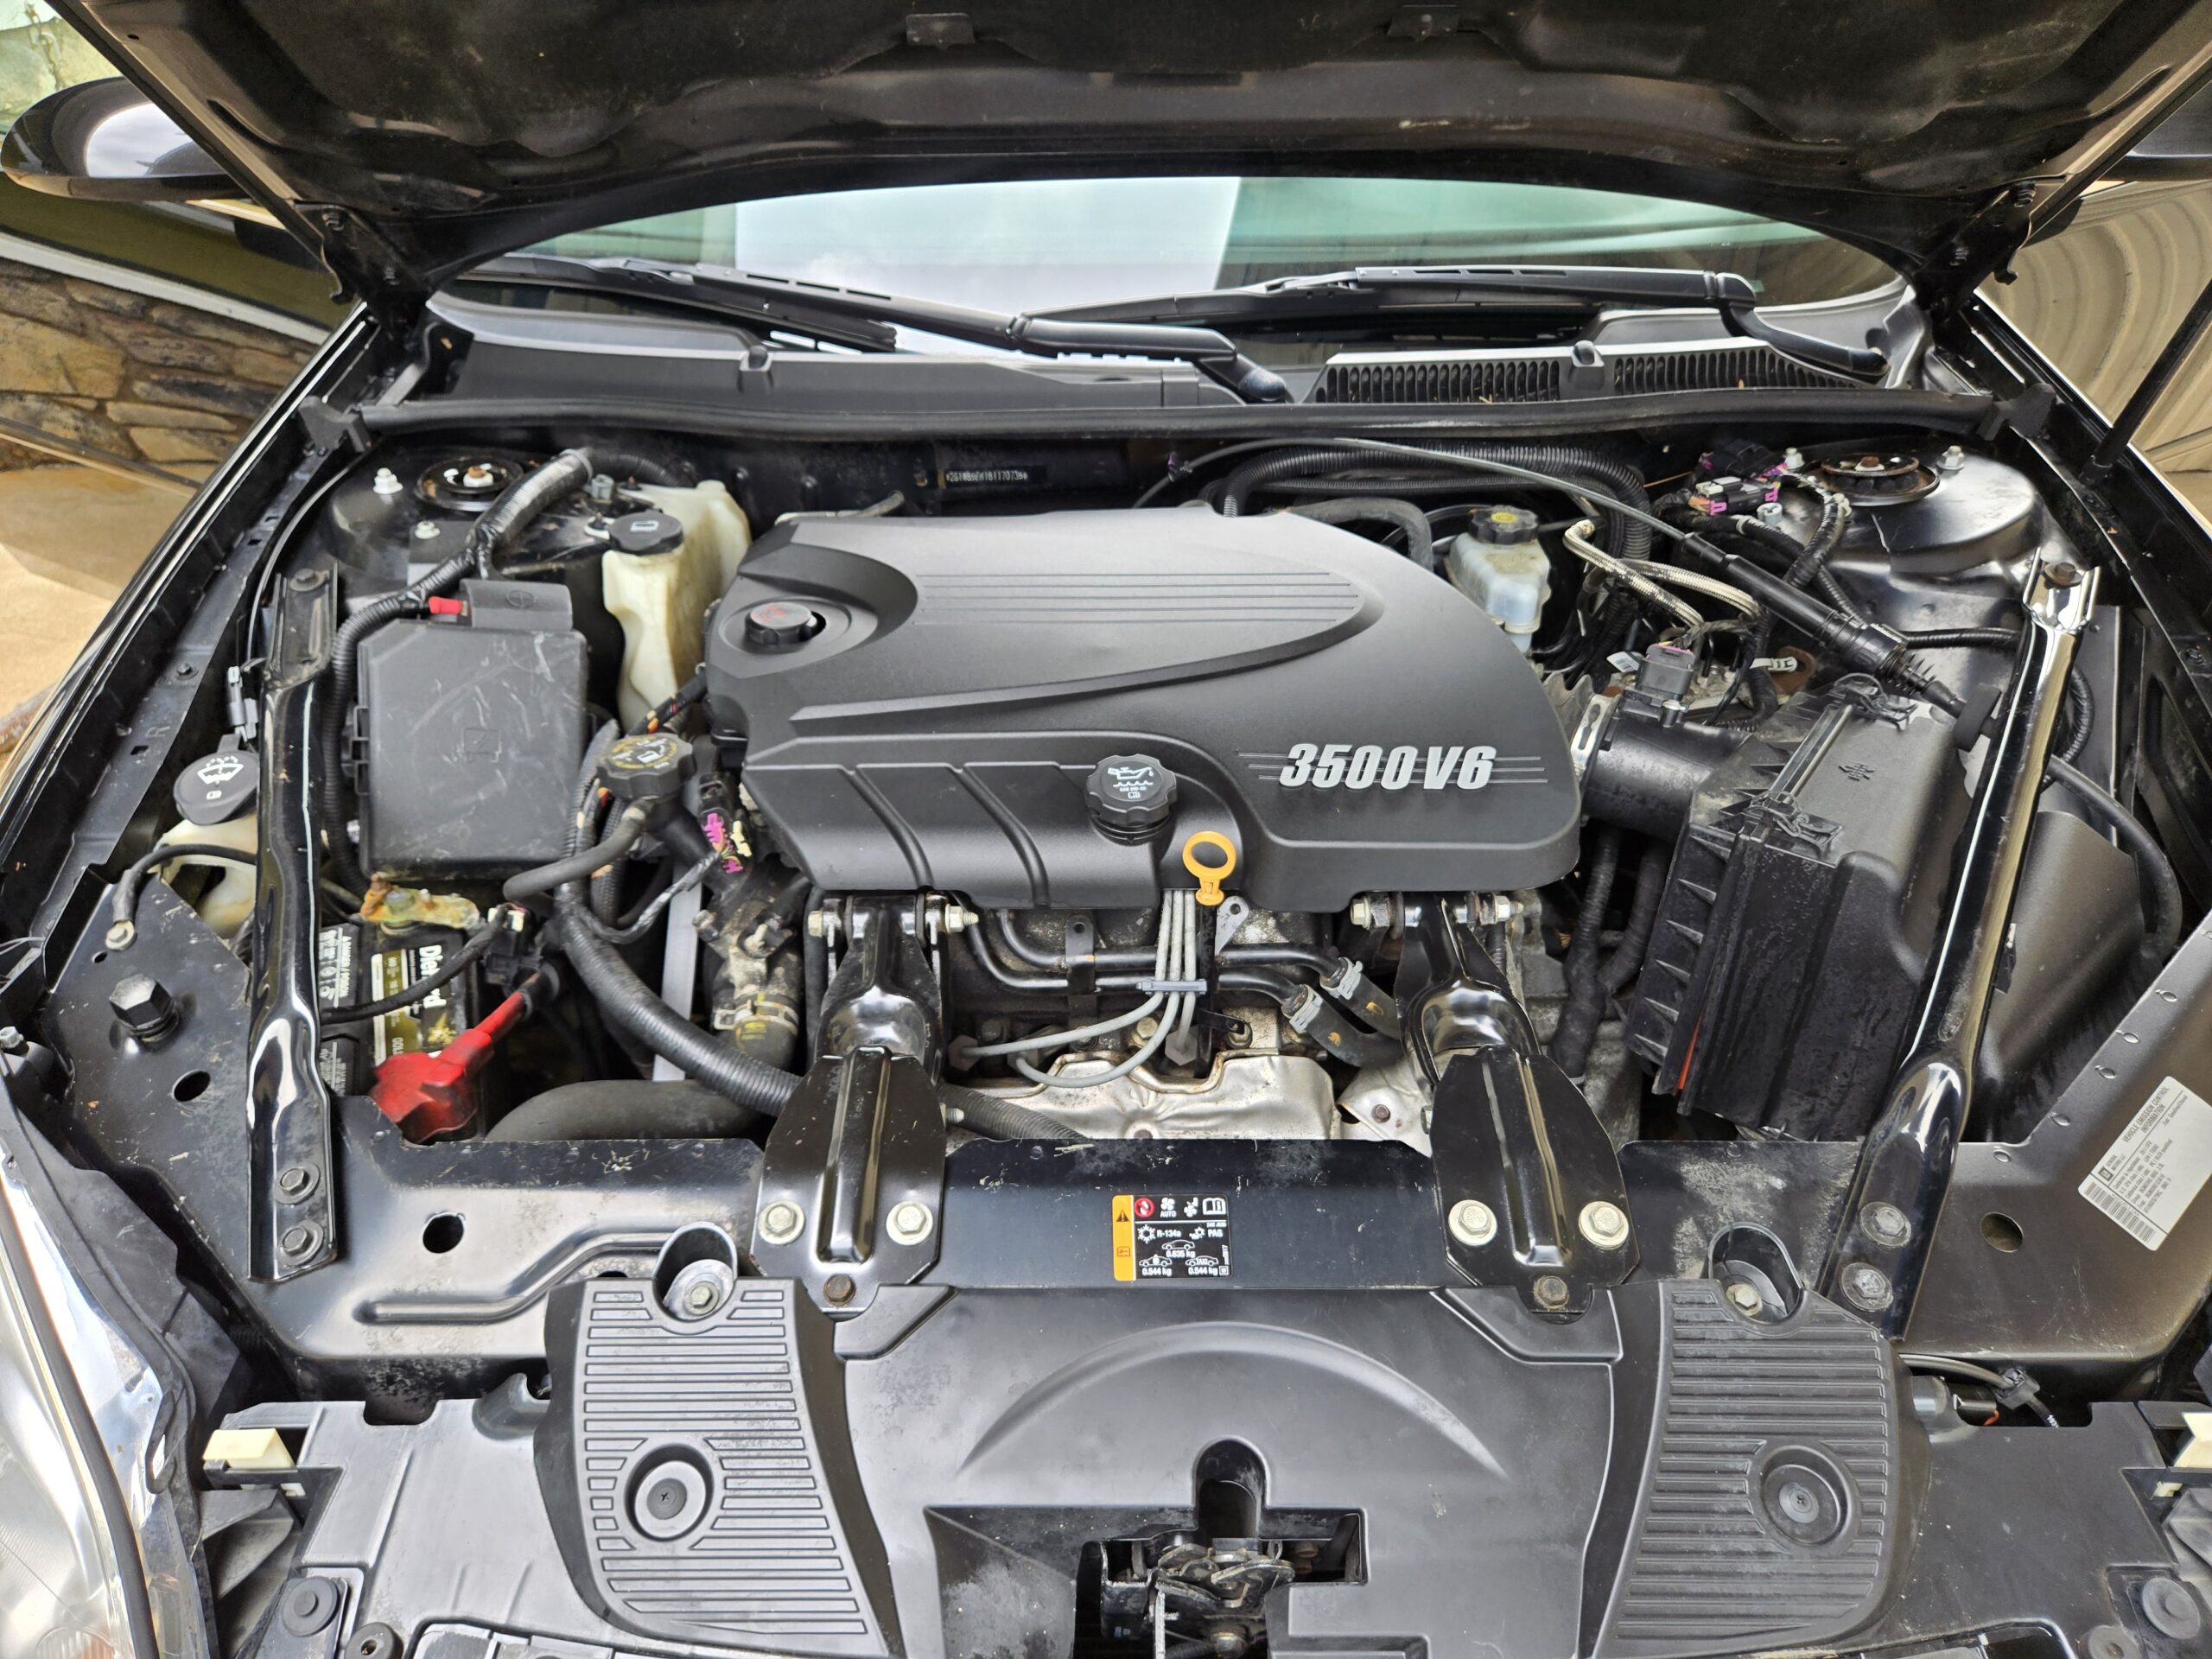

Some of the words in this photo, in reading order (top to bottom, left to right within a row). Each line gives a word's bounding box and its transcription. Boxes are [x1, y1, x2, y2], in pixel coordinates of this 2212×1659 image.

[1279, 743, 1418, 790] 3500
[1424, 746, 1497, 790] V6
[1208, 1229, 1224, 1237] PAG
[1186, 1249, 1196, 1259] kg
[1162, 1267, 1173, 1277] kg
[1209, 1267, 1218, 1276] kg
